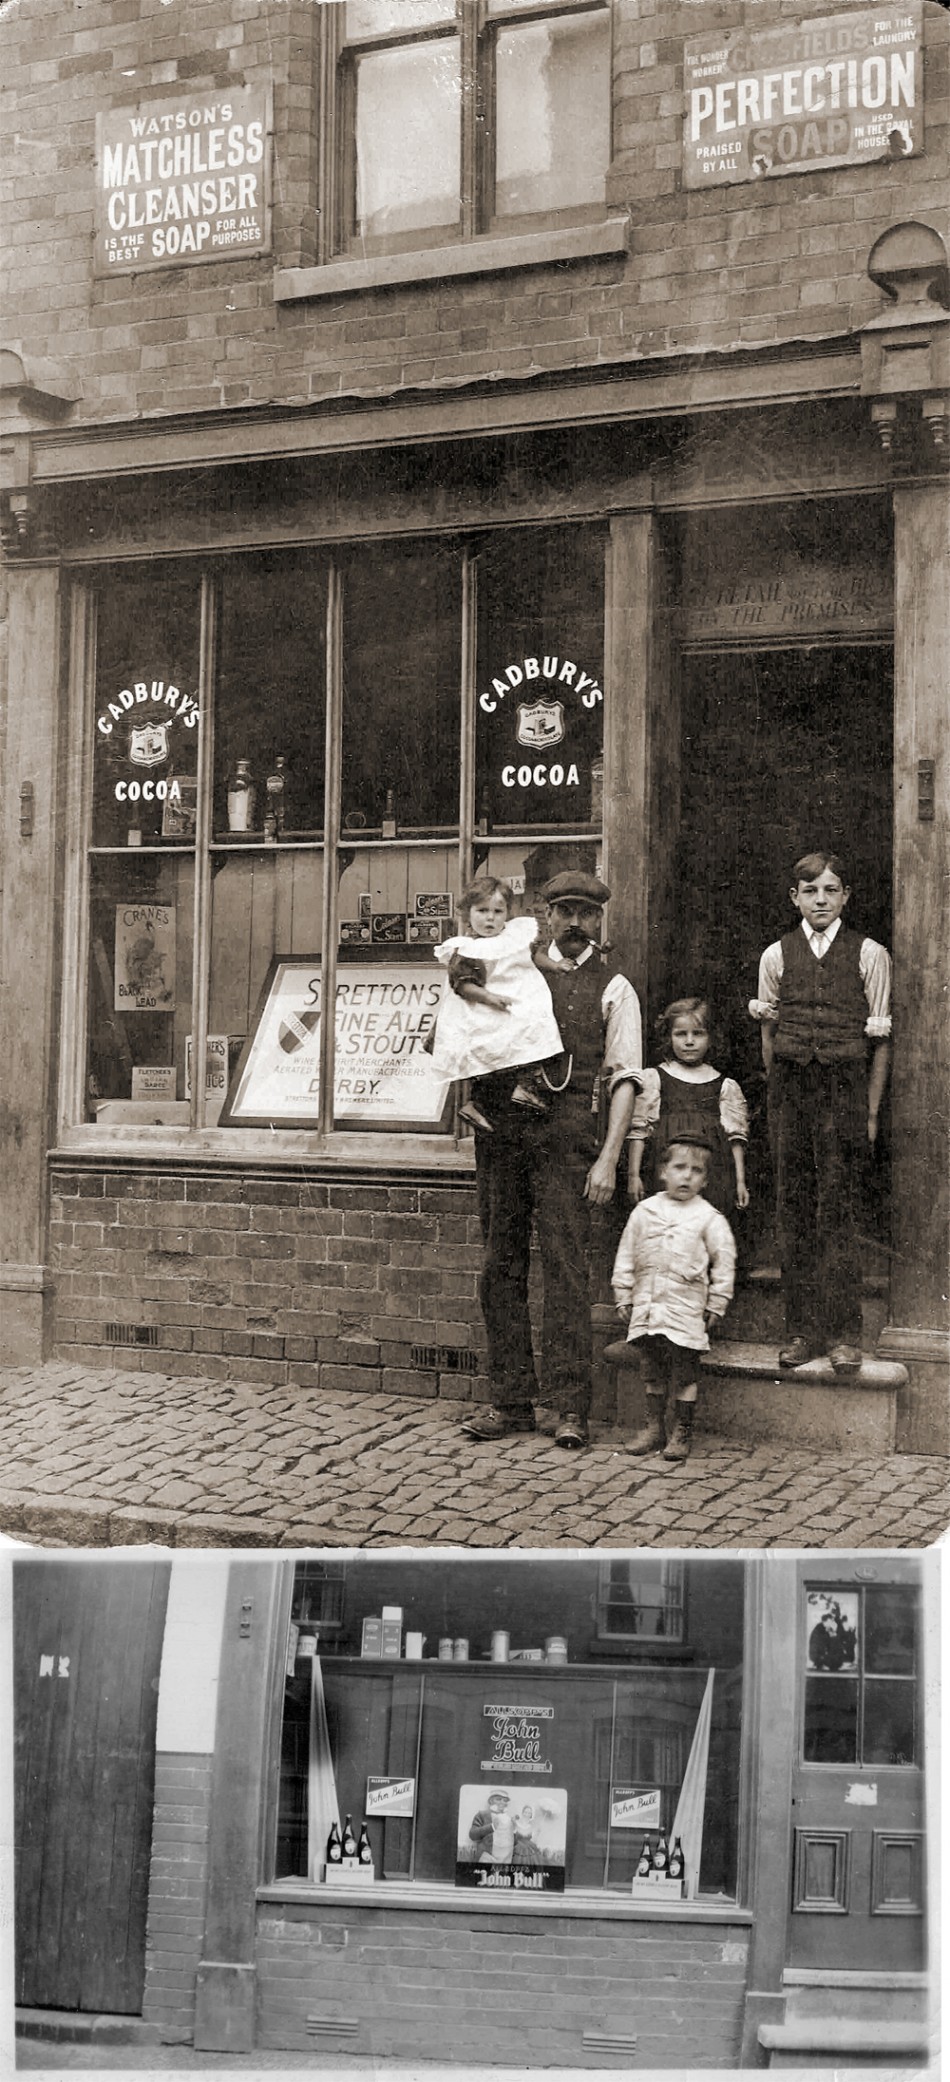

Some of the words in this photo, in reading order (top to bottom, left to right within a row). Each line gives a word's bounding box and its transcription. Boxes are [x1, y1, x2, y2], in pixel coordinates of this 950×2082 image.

[875, 20, 892, 32] FOR
[895, 17, 914, 29] THE
[873, 30, 917, 47] LAUNDRY
[690, 51, 916, 142] PERFECTION
[128, 104, 233, 138] WATSON'S
[855, 126, 864, 137] IN
[867, 123, 884, 135] THE
[753, 118, 848, 162] SOAP
[103, 121, 264, 189] MATCHLESS
[696, 142, 742, 160] PRAISED
[703, 160, 717, 173] BY
[719, 157, 738, 171] ALL
[108, 173, 258, 231] CLEANSER
[216, 219, 237, 232] FOR
[239, 216, 258, 228] ALL
[105, 237, 117, 250] IS
[120, 233, 145, 248] THE
[152, 221, 211, 257] SOAP
[212, 227, 262, 246] PURPOSES
[109, 247, 140, 262] BEST
[479, 656, 604, 714] CADBURY'S
[98, 681, 200, 734] CADBURY'S
[501, 764, 580, 788] COCOA
[115, 780, 181, 801] COCOA
[123, 907, 169, 927] CRANE'S
[136, 997, 157, 1007] LEAD
[304, 979, 442, 1006] SRETTONS
[348, 1067, 426, 1077] MANUFACTURERS
[356, 1058, 412, 1067] MERCHANTS
[308, 1078, 381, 1095] DRBY.
[490, 1716, 541, 1741] John
[492, 1739, 542, 1762] Bull
[368, 1791, 389, 1807] John
[392, 1782, 411, 1798] Bull
[613, 1802, 635, 1818] John
[636, 1794, 658, 1809] Bull
